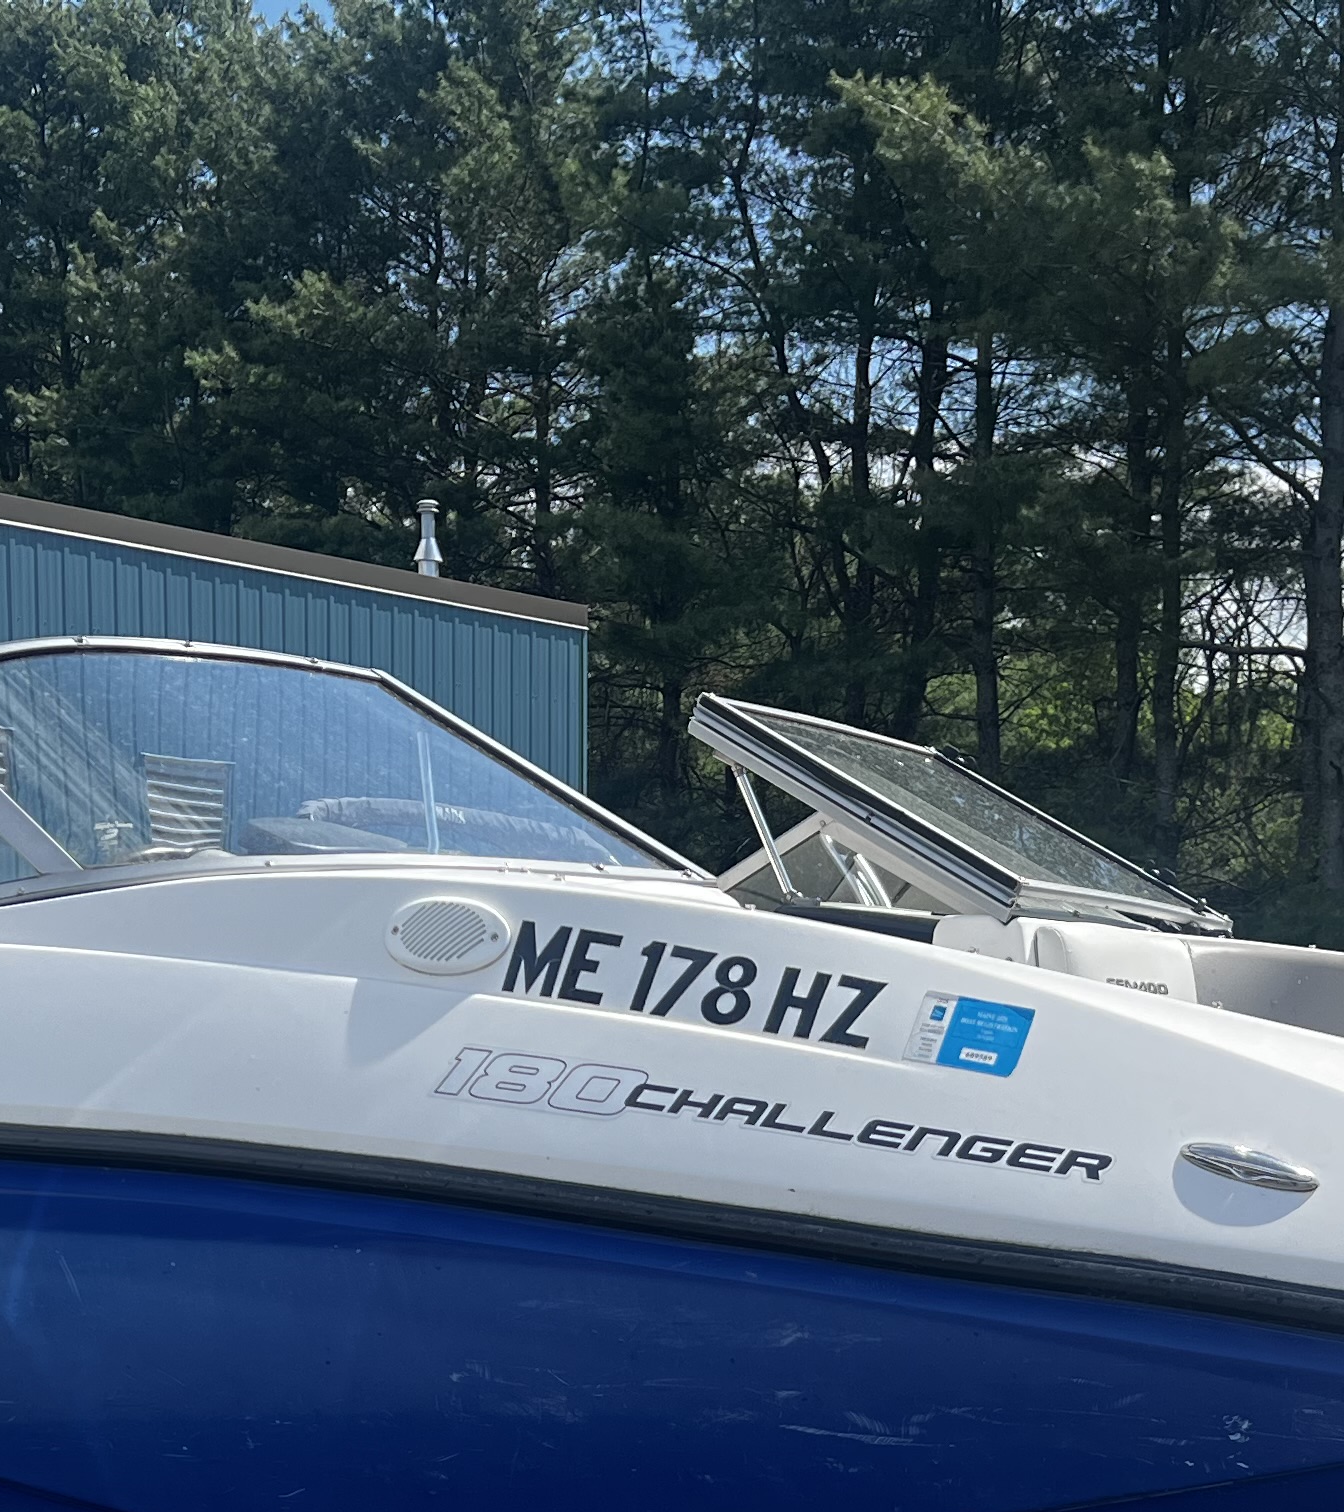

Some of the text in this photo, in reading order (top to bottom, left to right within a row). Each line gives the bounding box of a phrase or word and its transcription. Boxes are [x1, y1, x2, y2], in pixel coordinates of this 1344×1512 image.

[501, 920, 890, 1050] ME 178 HZ
[433, 1046, 1114, 1181] 180 CHALLENGER
